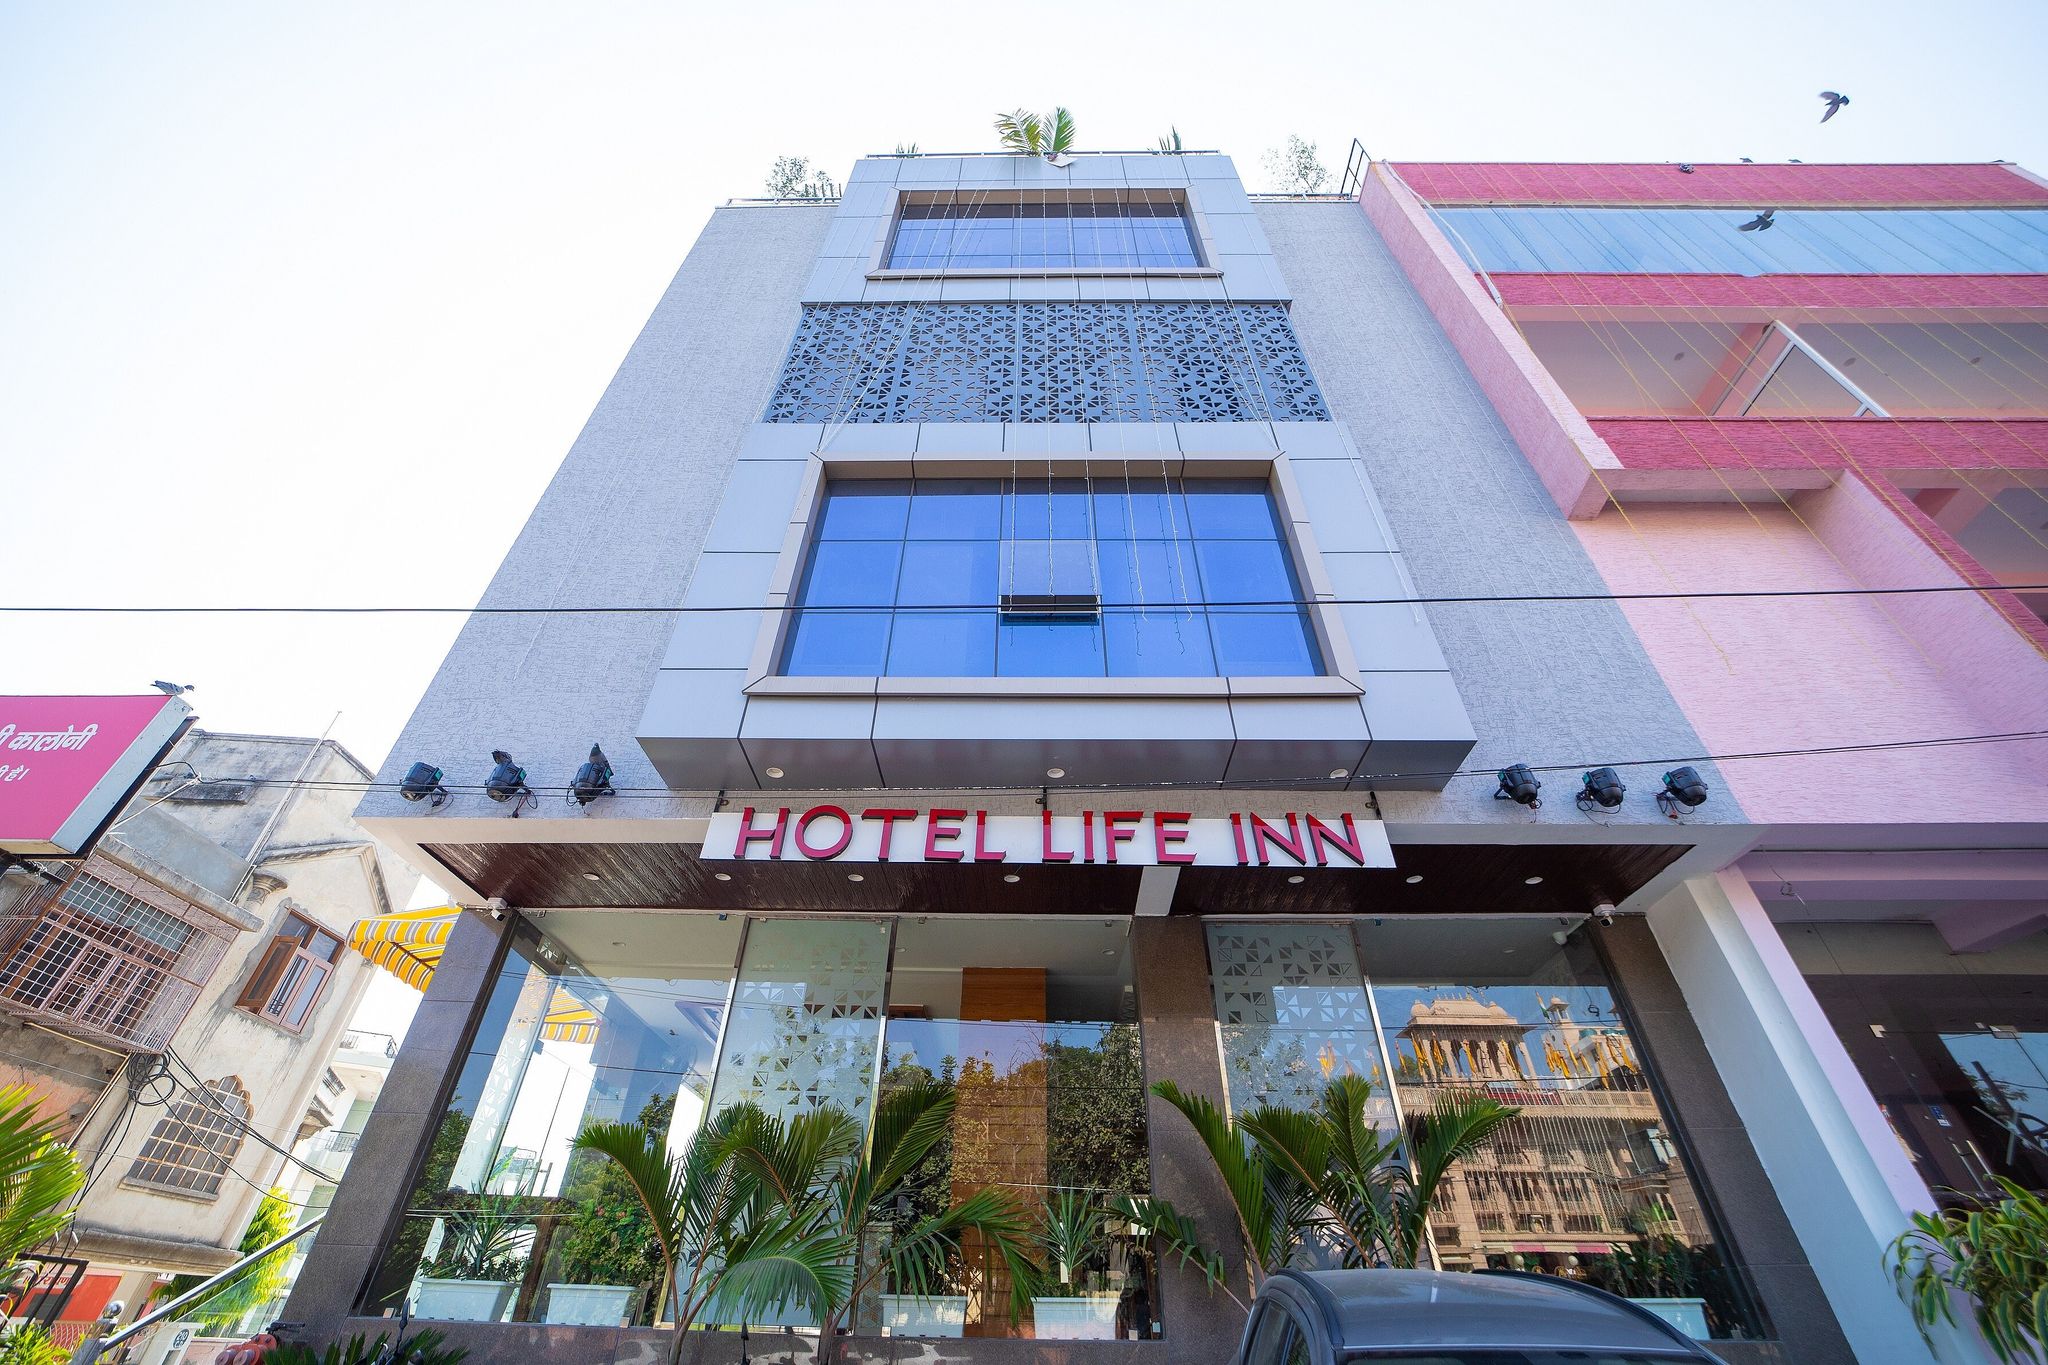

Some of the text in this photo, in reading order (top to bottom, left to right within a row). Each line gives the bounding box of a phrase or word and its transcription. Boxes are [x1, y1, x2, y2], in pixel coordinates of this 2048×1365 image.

[8, 723, 98, 751] कालोनी
[734, 804, 1365, 866] HOTEL LIFE INN
